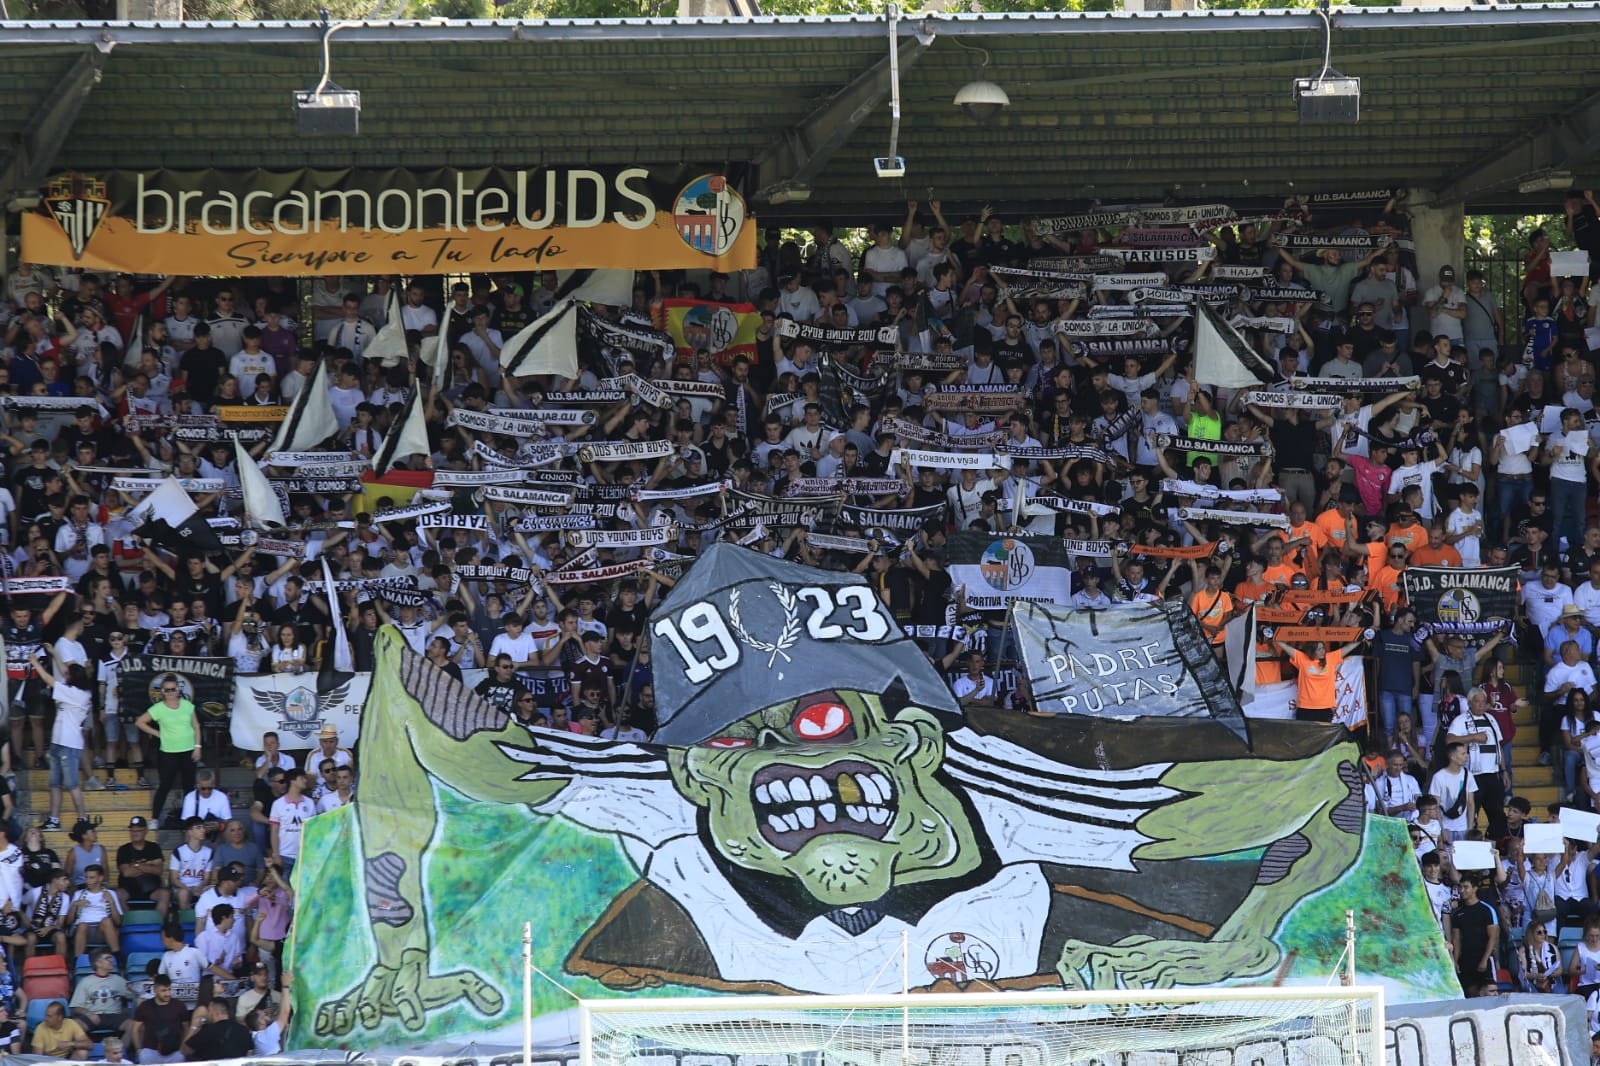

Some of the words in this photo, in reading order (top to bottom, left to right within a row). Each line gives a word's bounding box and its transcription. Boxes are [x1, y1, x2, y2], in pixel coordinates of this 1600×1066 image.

[137, 168, 656, 235] bracamonteUDS
[1143, 211, 1171, 221] SOMOS
[1187, 209, 1198, 218] LA
[1133, 233, 1195, 243] SALAMANCA
[1313, 236, 1372, 247] SALAMANCA
[226, 240, 373, 268] Siempre
[391, 249, 418, 261] a
[421, 237, 473, 268] Tu
[490, 236, 567, 264] lado
[1120, 249, 1198, 262] TARUSOS
[1230, 268, 1258, 277] HALA
[1111, 276, 1159, 286] Salmantino
[1260, 290, 1317, 300] SALAMANCA
[1064, 322, 1091, 332] SOMOS
[1108, 321, 1118, 332] LA
[1089, 339, 1169, 351] SALAMANCA
[638, 380, 660, 400] BOYS
[959, 384, 1018, 393] SALAMANCA
[564, 391, 626, 401] SALAMANCA
[1255, 392, 1284, 403] SOMOS
[1302, 396, 1313, 405] LA
[459, 413, 486, 428] SOMOS
[503, 421, 513, 430] LA
[615, 442, 644, 455] YOUNG
[647, 440, 669, 453] BOYS
[1194, 440, 1255, 453] SALAMANCA
[293, 452, 344, 463] Salmantino
[536, 451, 556, 463] UDS
[917, 454, 959, 465] VIAJEROS
[503, 488, 566, 503] SALAMANCA
[585, 532, 604, 544] UDS
[607, 531, 637, 542] YOUNG
[641, 527, 664, 540] BOYS
[1085, 541, 1110, 554] BOYS
[1412, 576, 1435, 592] U.D.
[1440, 575, 1511, 592] SALAMANCA
[653, 601, 741, 684] 19
[797, 585, 889, 642] 23
[121, 657, 146, 673] U.D.
[152, 656, 227, 678] SALAMANCA
[1047, 641, 1169, 684] PADRE
[1060, 673, 1179, 713] PUTAS
